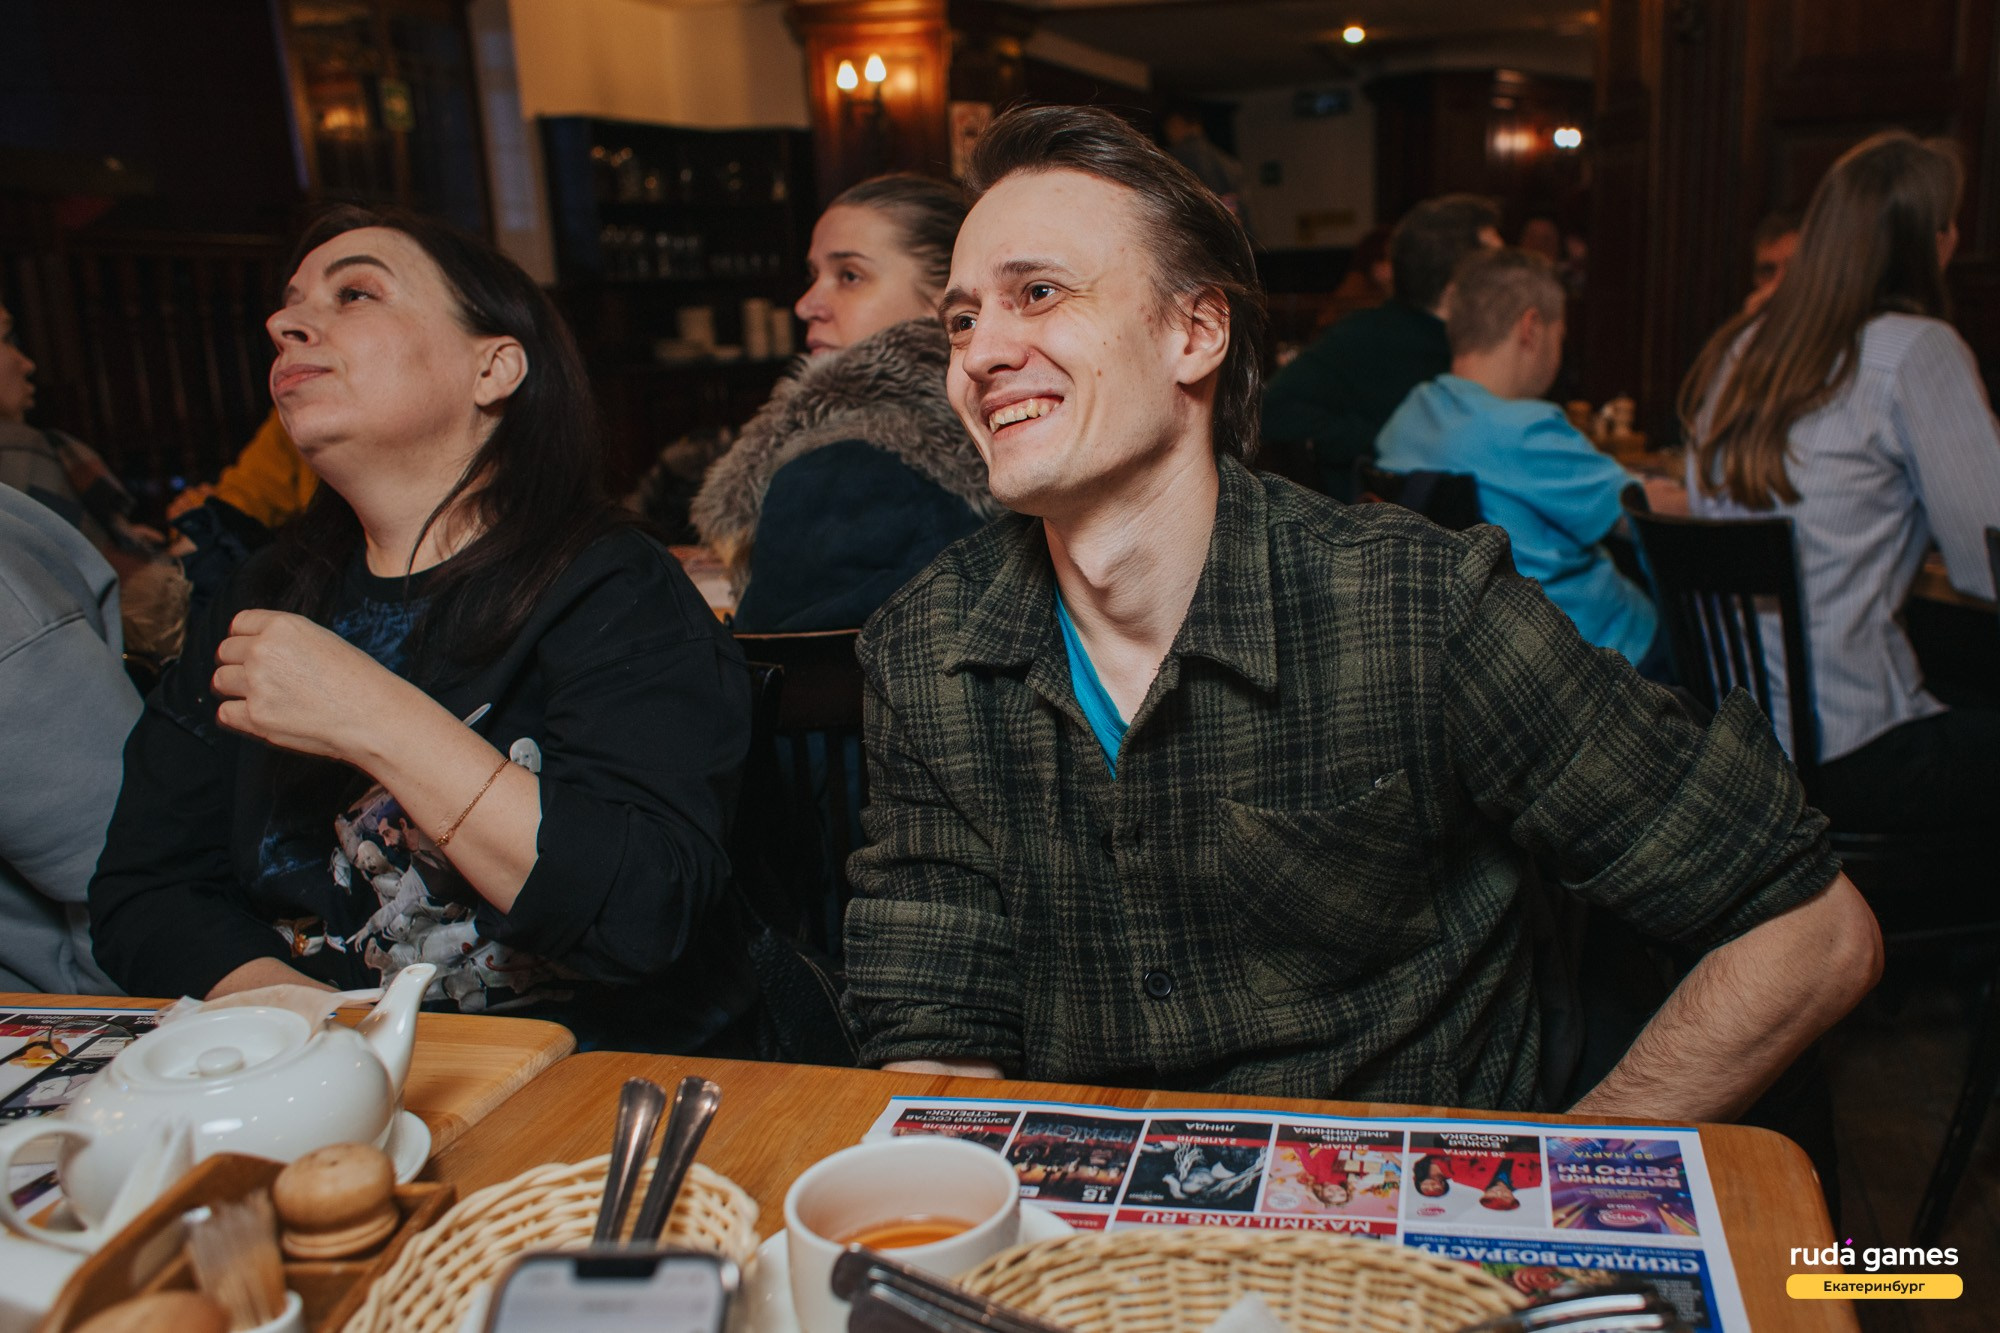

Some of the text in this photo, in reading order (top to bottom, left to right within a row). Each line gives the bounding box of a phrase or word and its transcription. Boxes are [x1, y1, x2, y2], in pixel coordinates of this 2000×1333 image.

[926, 1109, 997, 1117] «СТРЕЛОК»
[906, 1114, 1011, 1124] ЗОЛОТОЙ СОСТАВ
[922, 1122, 971, 1131] АПРЕЛЯ
[1186, 1122, 1236, 1132] ЛИНДА
[1293, 1127, 1389, 1138] ИМЕНИННИКА
[1177, 1136, 1227, 1144] АПРЕЛЯ
[1440, 1133, 1509, 1142] КОРОВКА
[1309, 1142, 1352, 1150] МАРТА
[1449, 1140, 1500, 1148] БОЖЬЯ
[1443, 1148, 1488, 1157] МАРТА
[1574, 1152, 1626, 1160] МАРТА
[1557, 1163, 1678, 1178] РЕТРО FM
[1559, 1174, 1681, 1188] ВЕЧЕРИНКА
[1081, 1189, 1108, 1202] 15
[1141, 1212, 1370, 1233] MAXIMILIANS.RU
